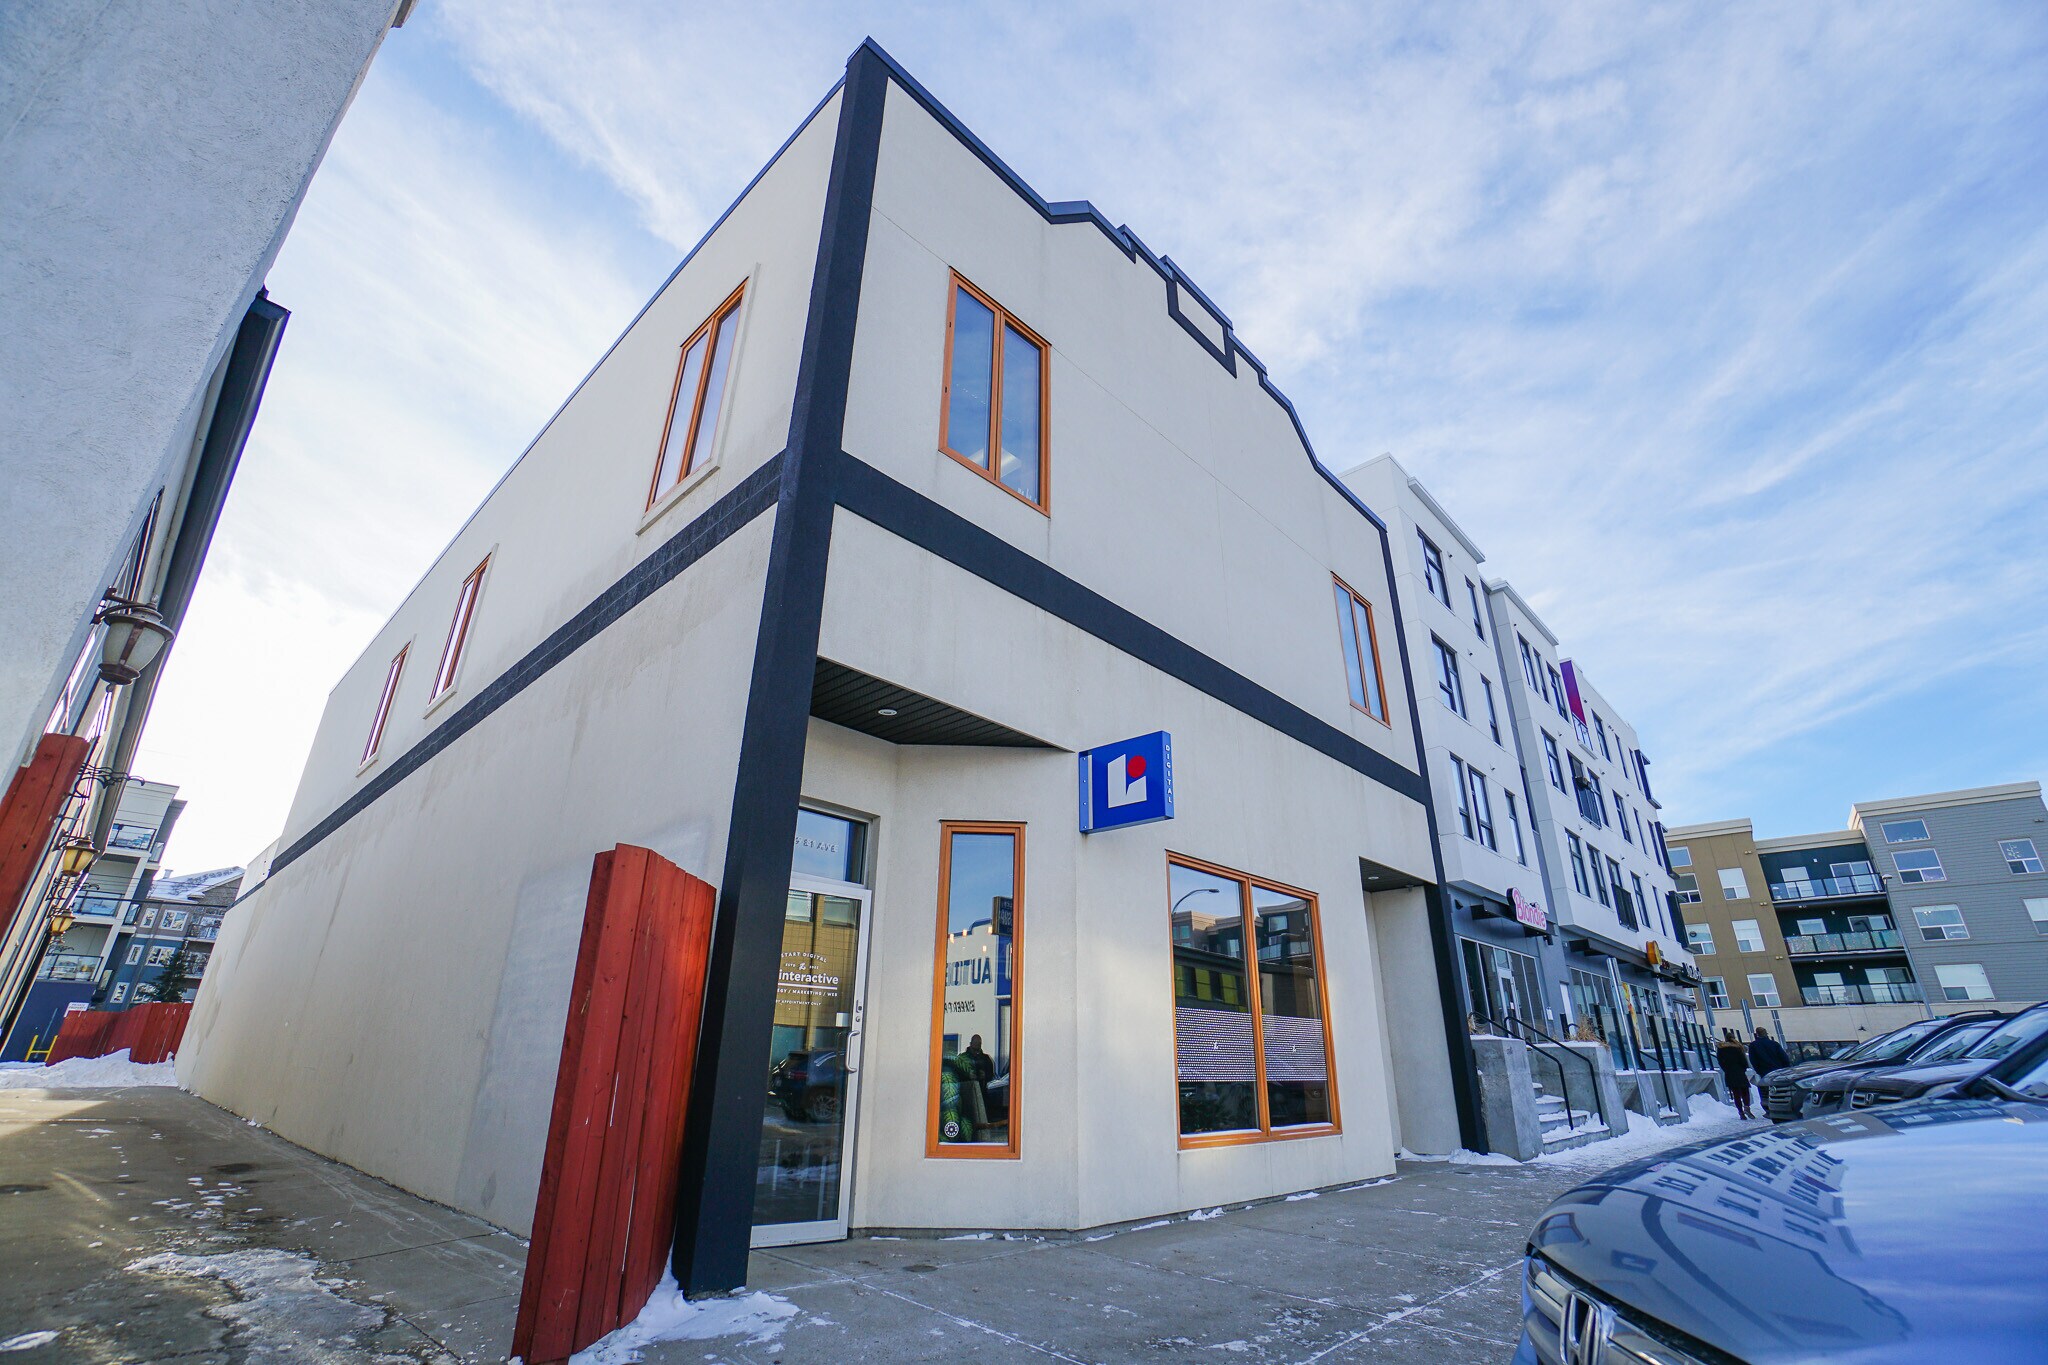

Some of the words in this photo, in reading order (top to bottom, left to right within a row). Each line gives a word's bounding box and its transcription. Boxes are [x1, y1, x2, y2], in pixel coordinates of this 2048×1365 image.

[1165, 744, 1173, 804] DIGITAL
[802, 952, 827, 963] DIGITAL
[778, 969, 839, 984] interactive
